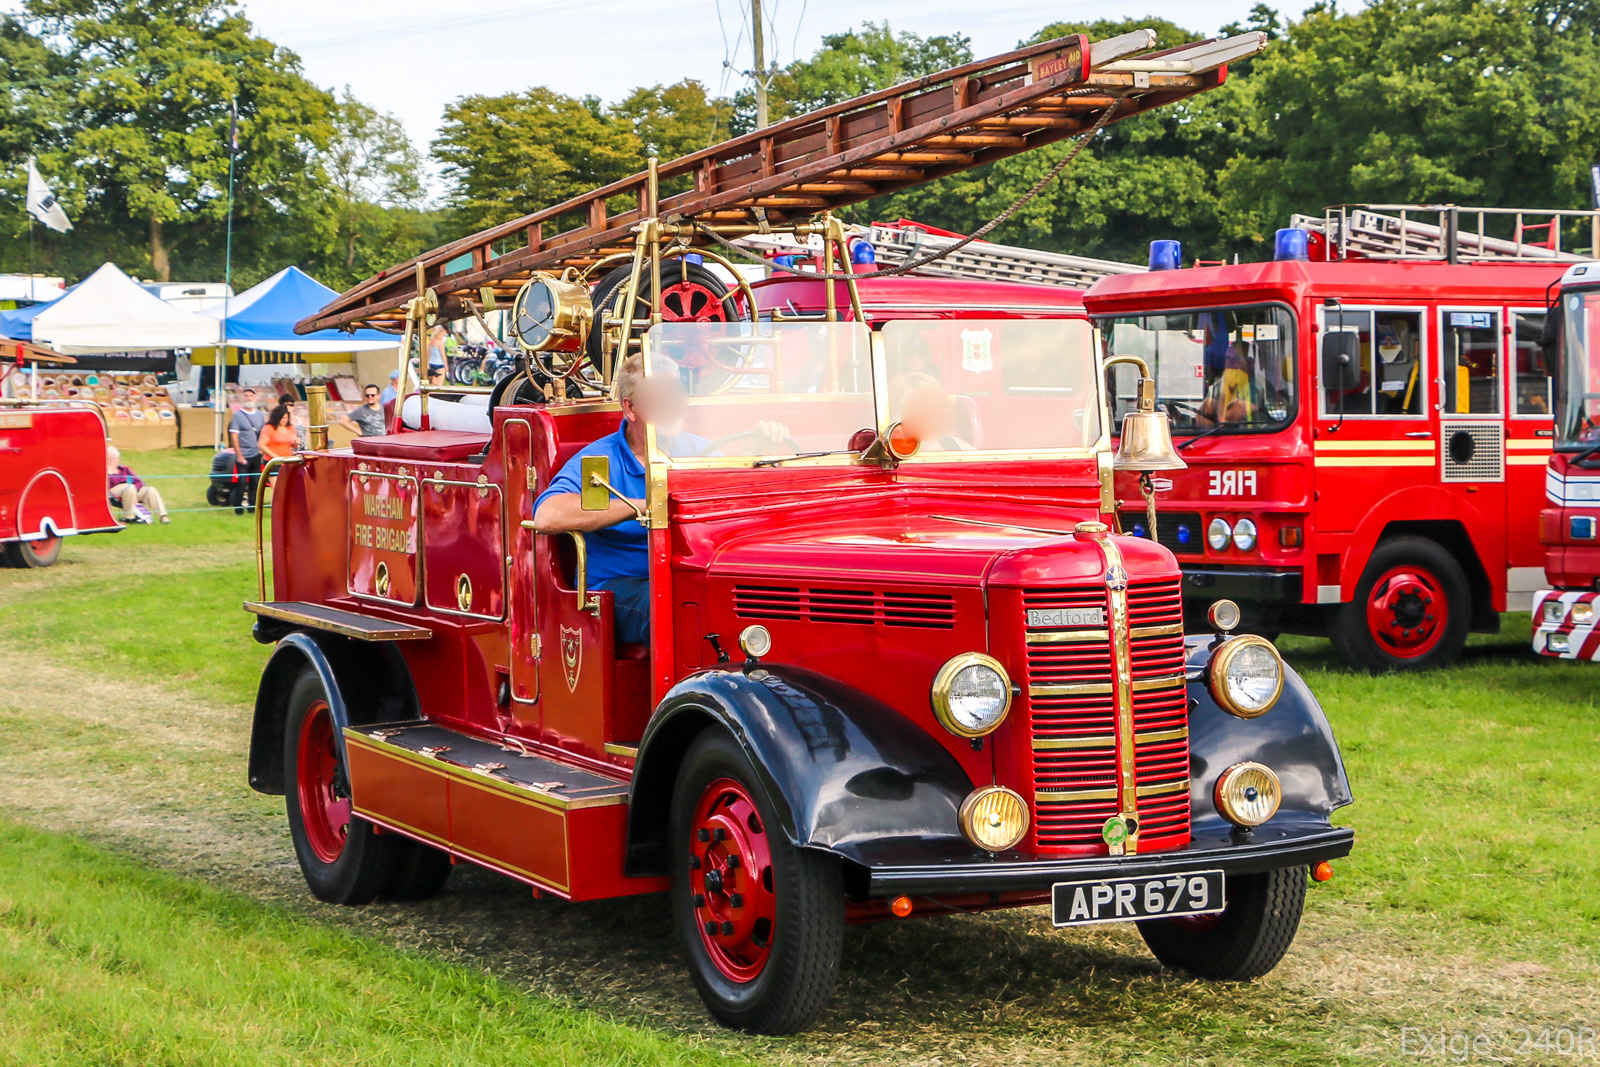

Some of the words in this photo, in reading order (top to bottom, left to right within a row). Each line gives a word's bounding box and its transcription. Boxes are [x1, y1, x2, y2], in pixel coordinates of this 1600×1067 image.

[1040, 58, 1067, 78] BAYLEY
[364, 493, 403, 520] WAREHAM
[354, 524, 373, 548] FIRE
[376, 526, 411, 554] BRIGADE
[1029, 609, 1100, 626] Bedford
[1069, 883, 1137, 920] APR
[1144, 876, 1208, 914] 679
